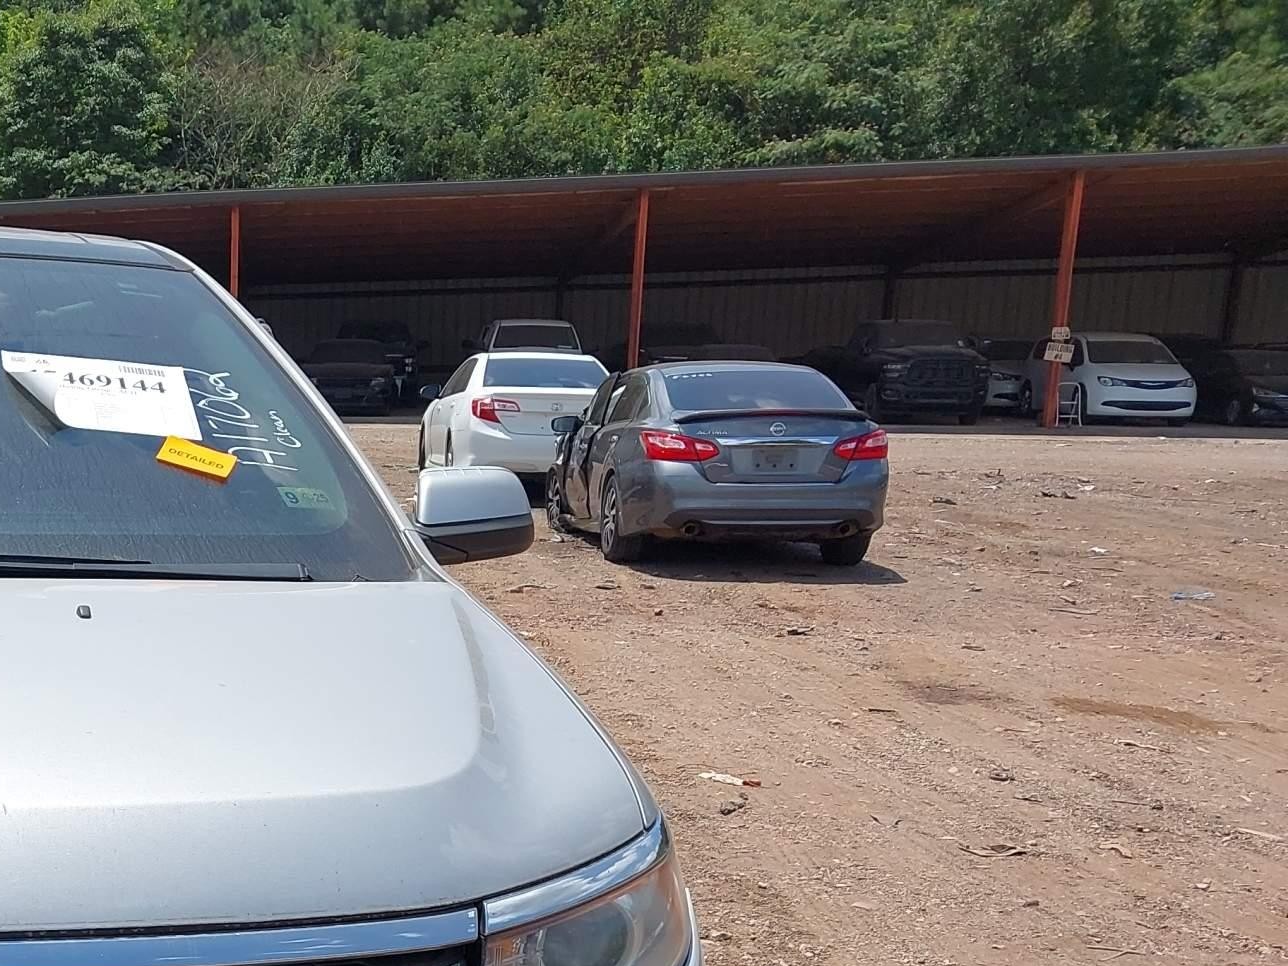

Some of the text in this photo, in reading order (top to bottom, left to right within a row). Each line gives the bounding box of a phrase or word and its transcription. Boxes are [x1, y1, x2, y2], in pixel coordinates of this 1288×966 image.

[30, 369, 167, 394] 469144
[168, 447, 224, 470] DETAILED
[285, 491, 299, 504] 9
